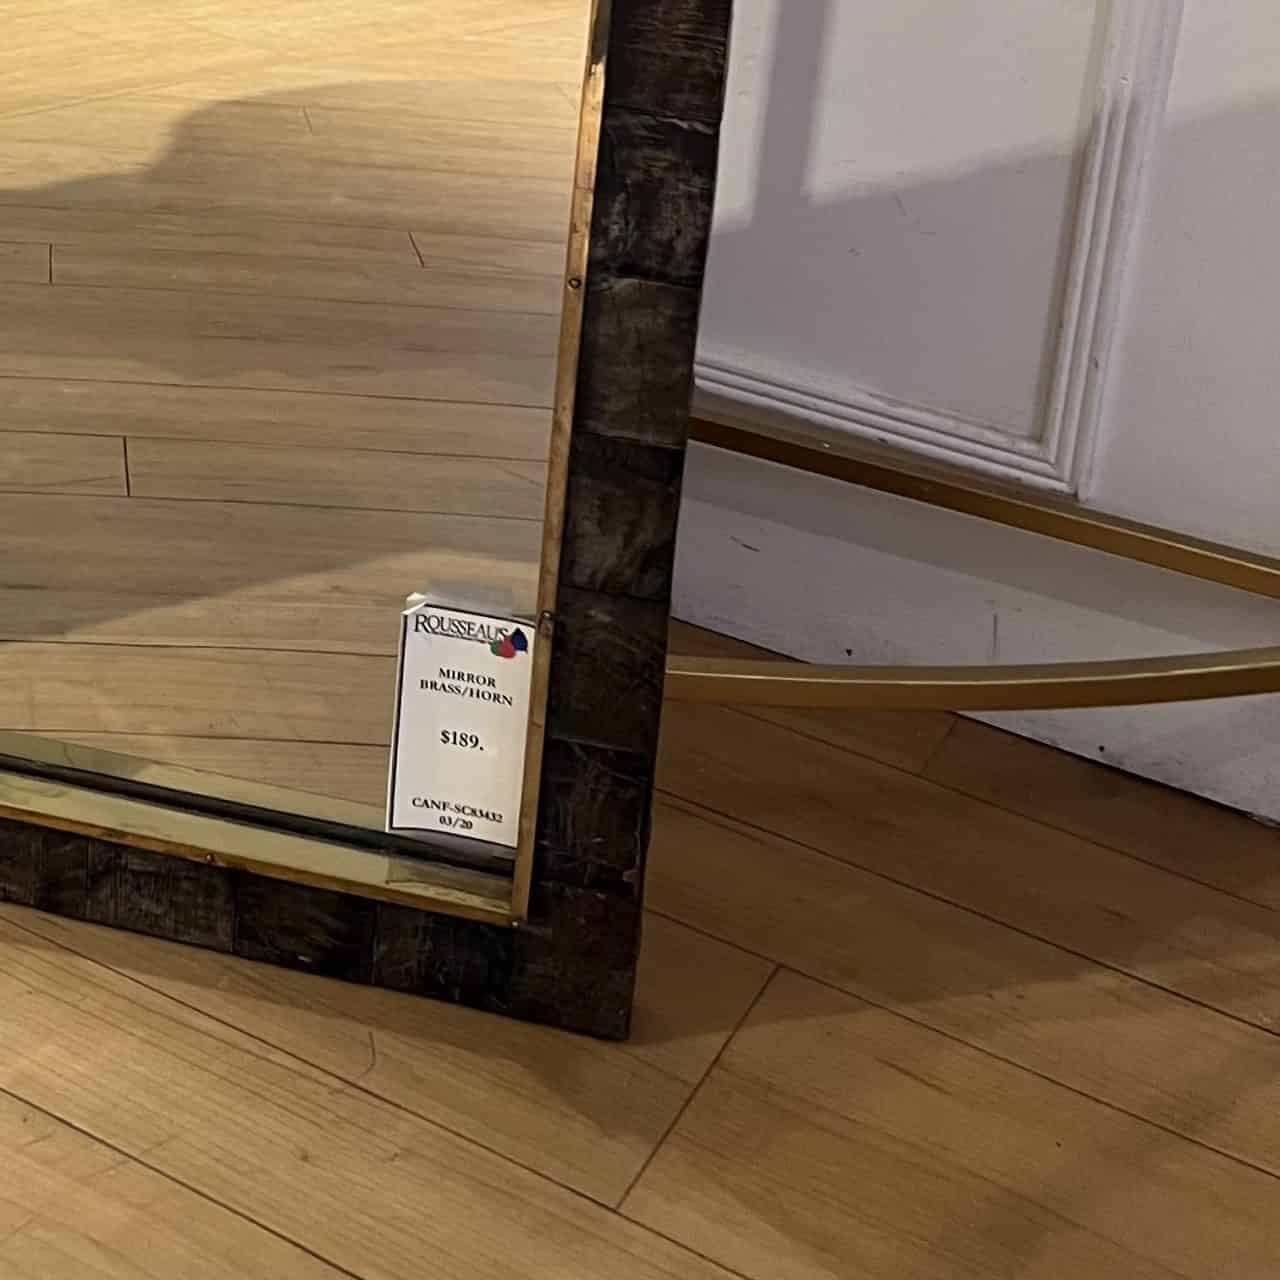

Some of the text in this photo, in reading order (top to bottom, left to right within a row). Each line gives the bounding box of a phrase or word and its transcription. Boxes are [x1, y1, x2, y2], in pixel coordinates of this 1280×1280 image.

[439, 667, 497, 689] MIRROR
[419, 679, 514, 706] BRASS/HORN
[440, 730, 485, 751] $189.
[439, 815, 475, 831] 03/20
